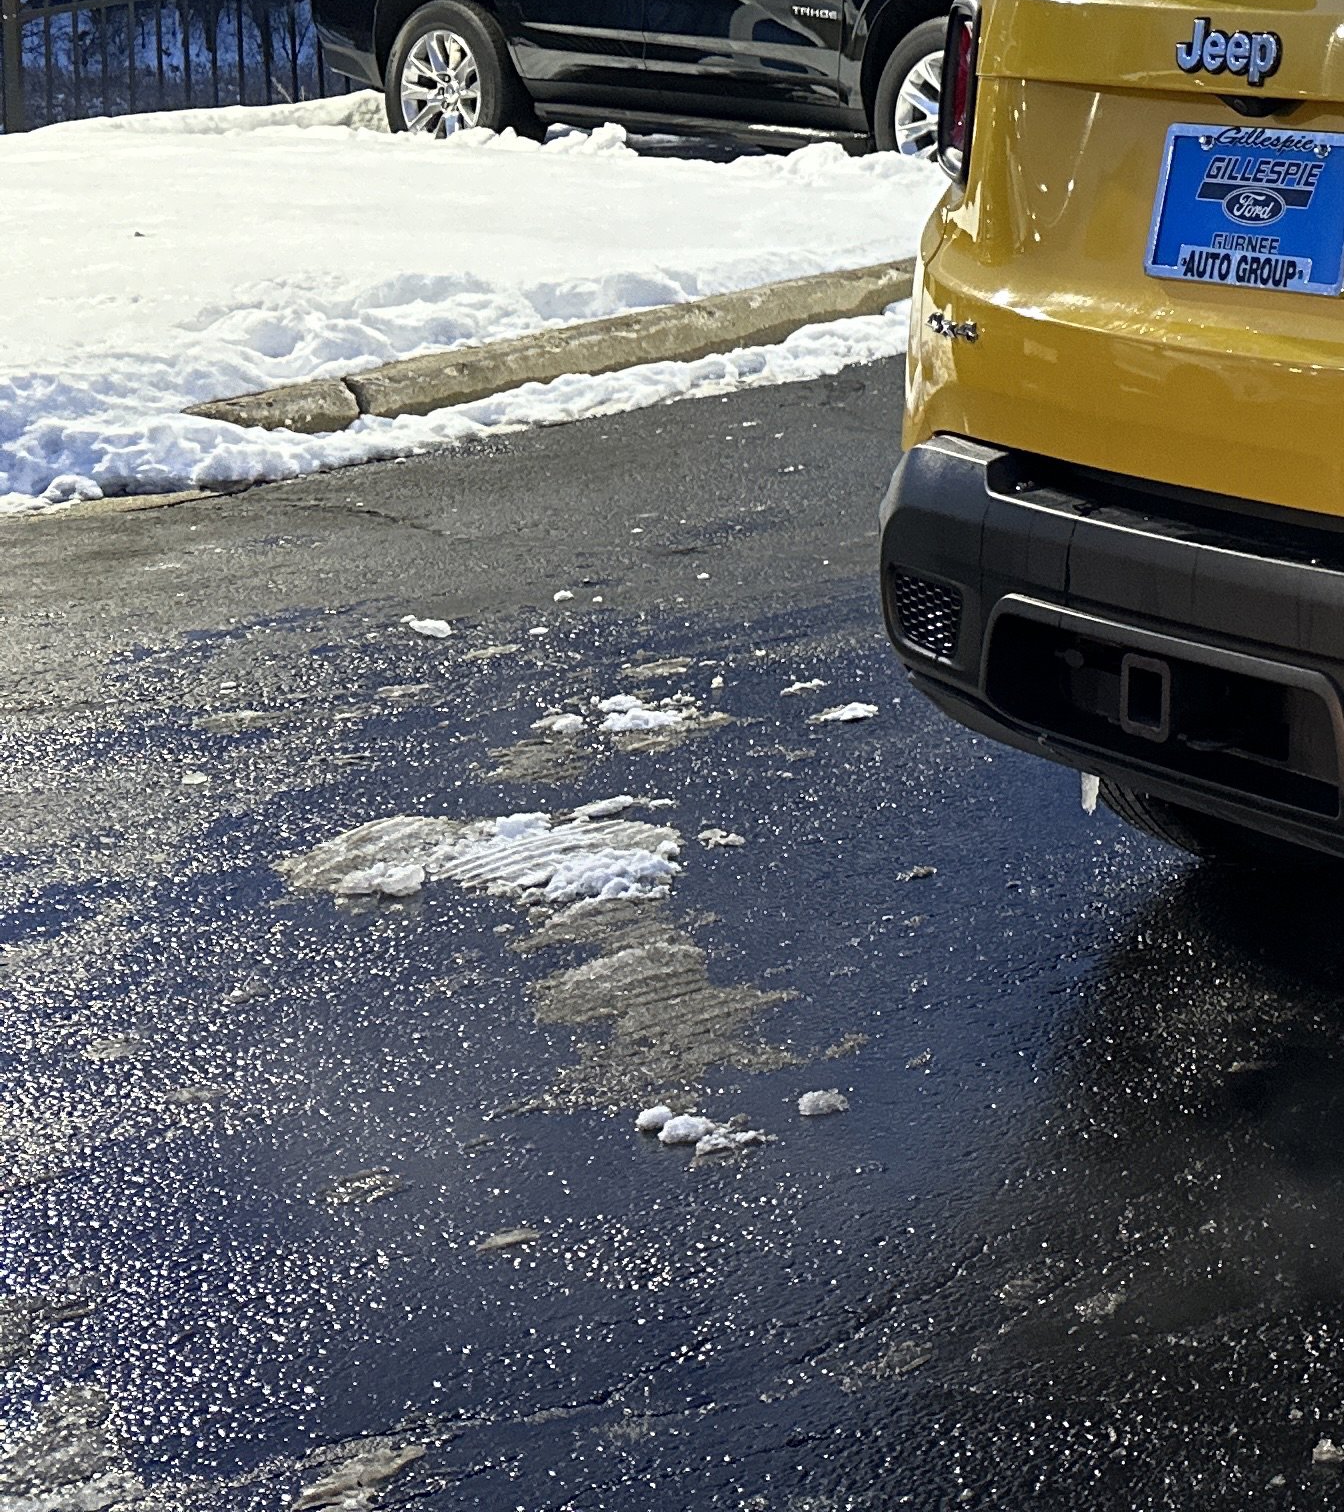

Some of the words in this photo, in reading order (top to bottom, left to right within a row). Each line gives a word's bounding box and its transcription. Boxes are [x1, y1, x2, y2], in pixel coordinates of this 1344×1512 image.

[1176, 17, 1283, 87] Jeep
[1216, 126, 1316, 155] Gillespie
[1205, 155, 1325, 188] GILLESPIE
[1232, 192, 1273, 220] Ford
[1211, 232, 1281, 255] GURNEE
[1183, 250, 1231, 281] AUTO
[1236, 254, 1298, 288] GROUP
